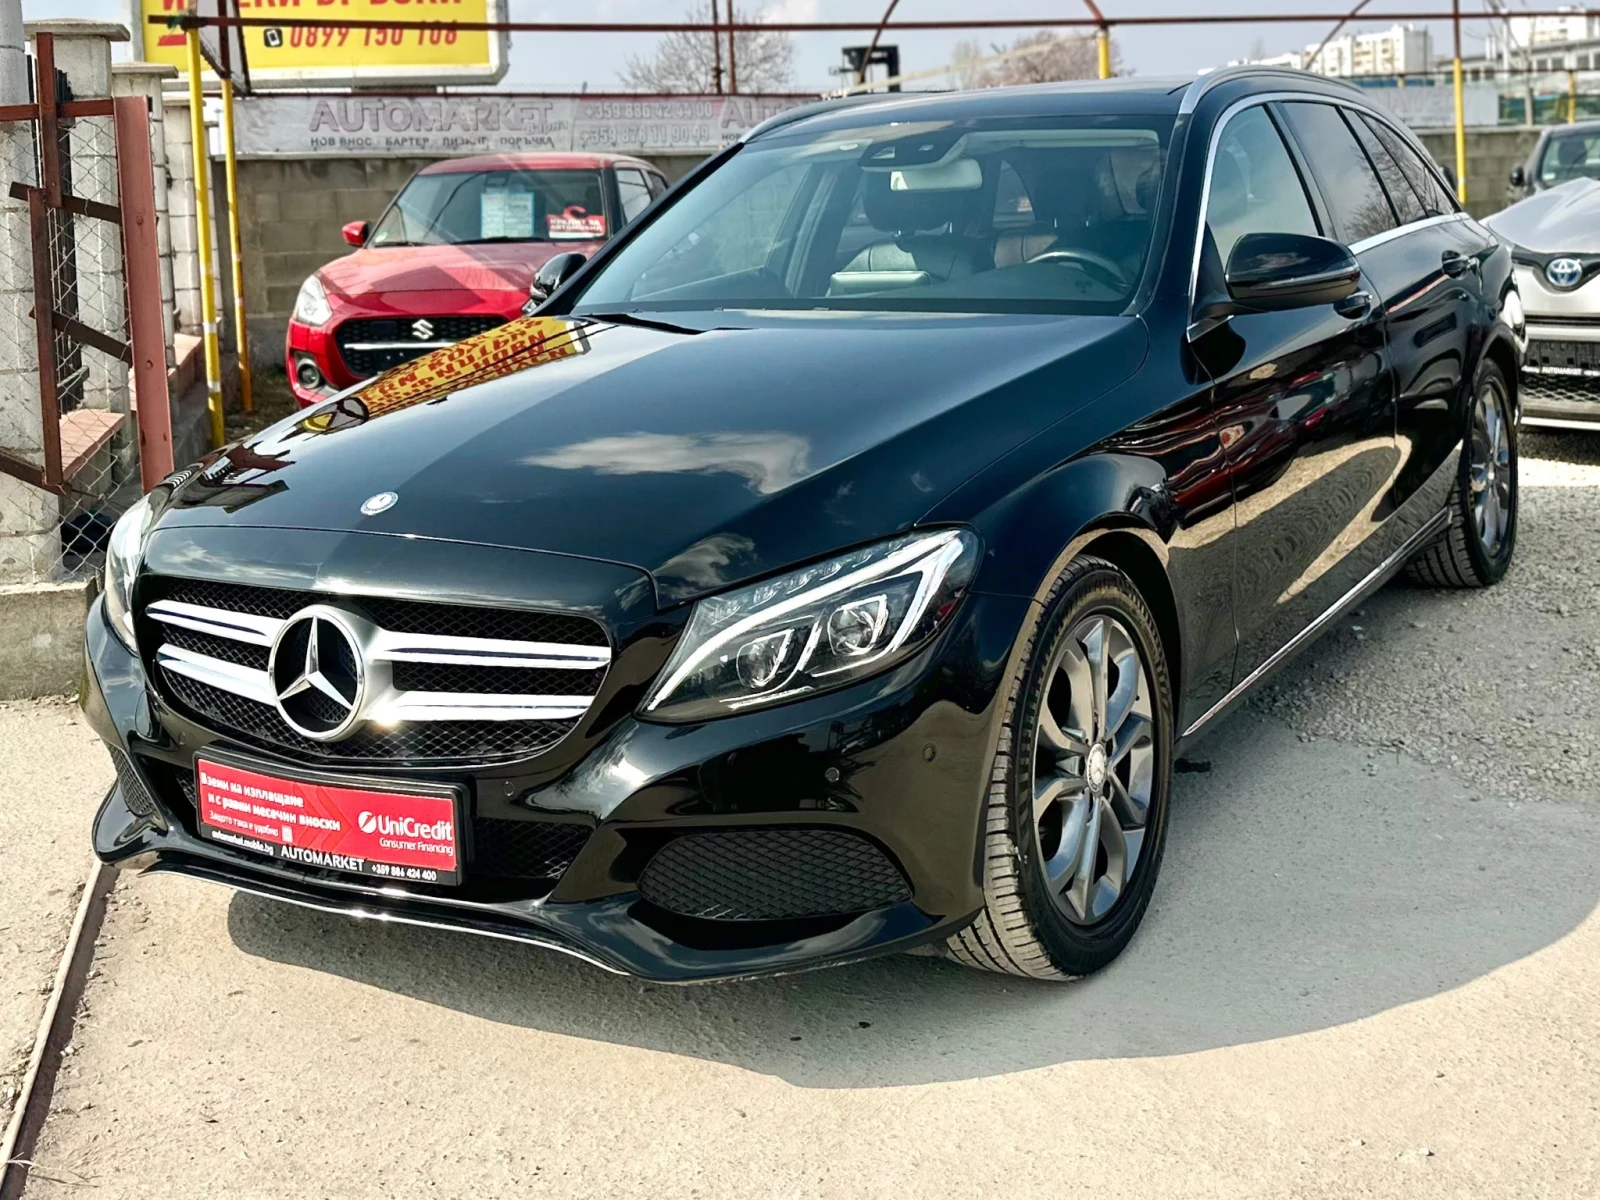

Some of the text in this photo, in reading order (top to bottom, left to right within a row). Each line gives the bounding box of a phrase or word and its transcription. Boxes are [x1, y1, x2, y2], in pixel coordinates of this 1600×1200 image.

[290, 25, 349, 47] 0899
[308, 99, 553, 133] AUTOMARKET
[385, 137, 430, 147] БАРТЕР
[200, 771, 304, 808] Вземи на изплащане
[222, 796, 251, 814] равни
[252, 804, 297, 824] месечни
[299, 814, 341, 831] вноски
[377, 814, 454, 841] UniCredit
[280, 844, 365, 872] AUTOMARKET
[379, 837, 454, 857] Consumer Financing
